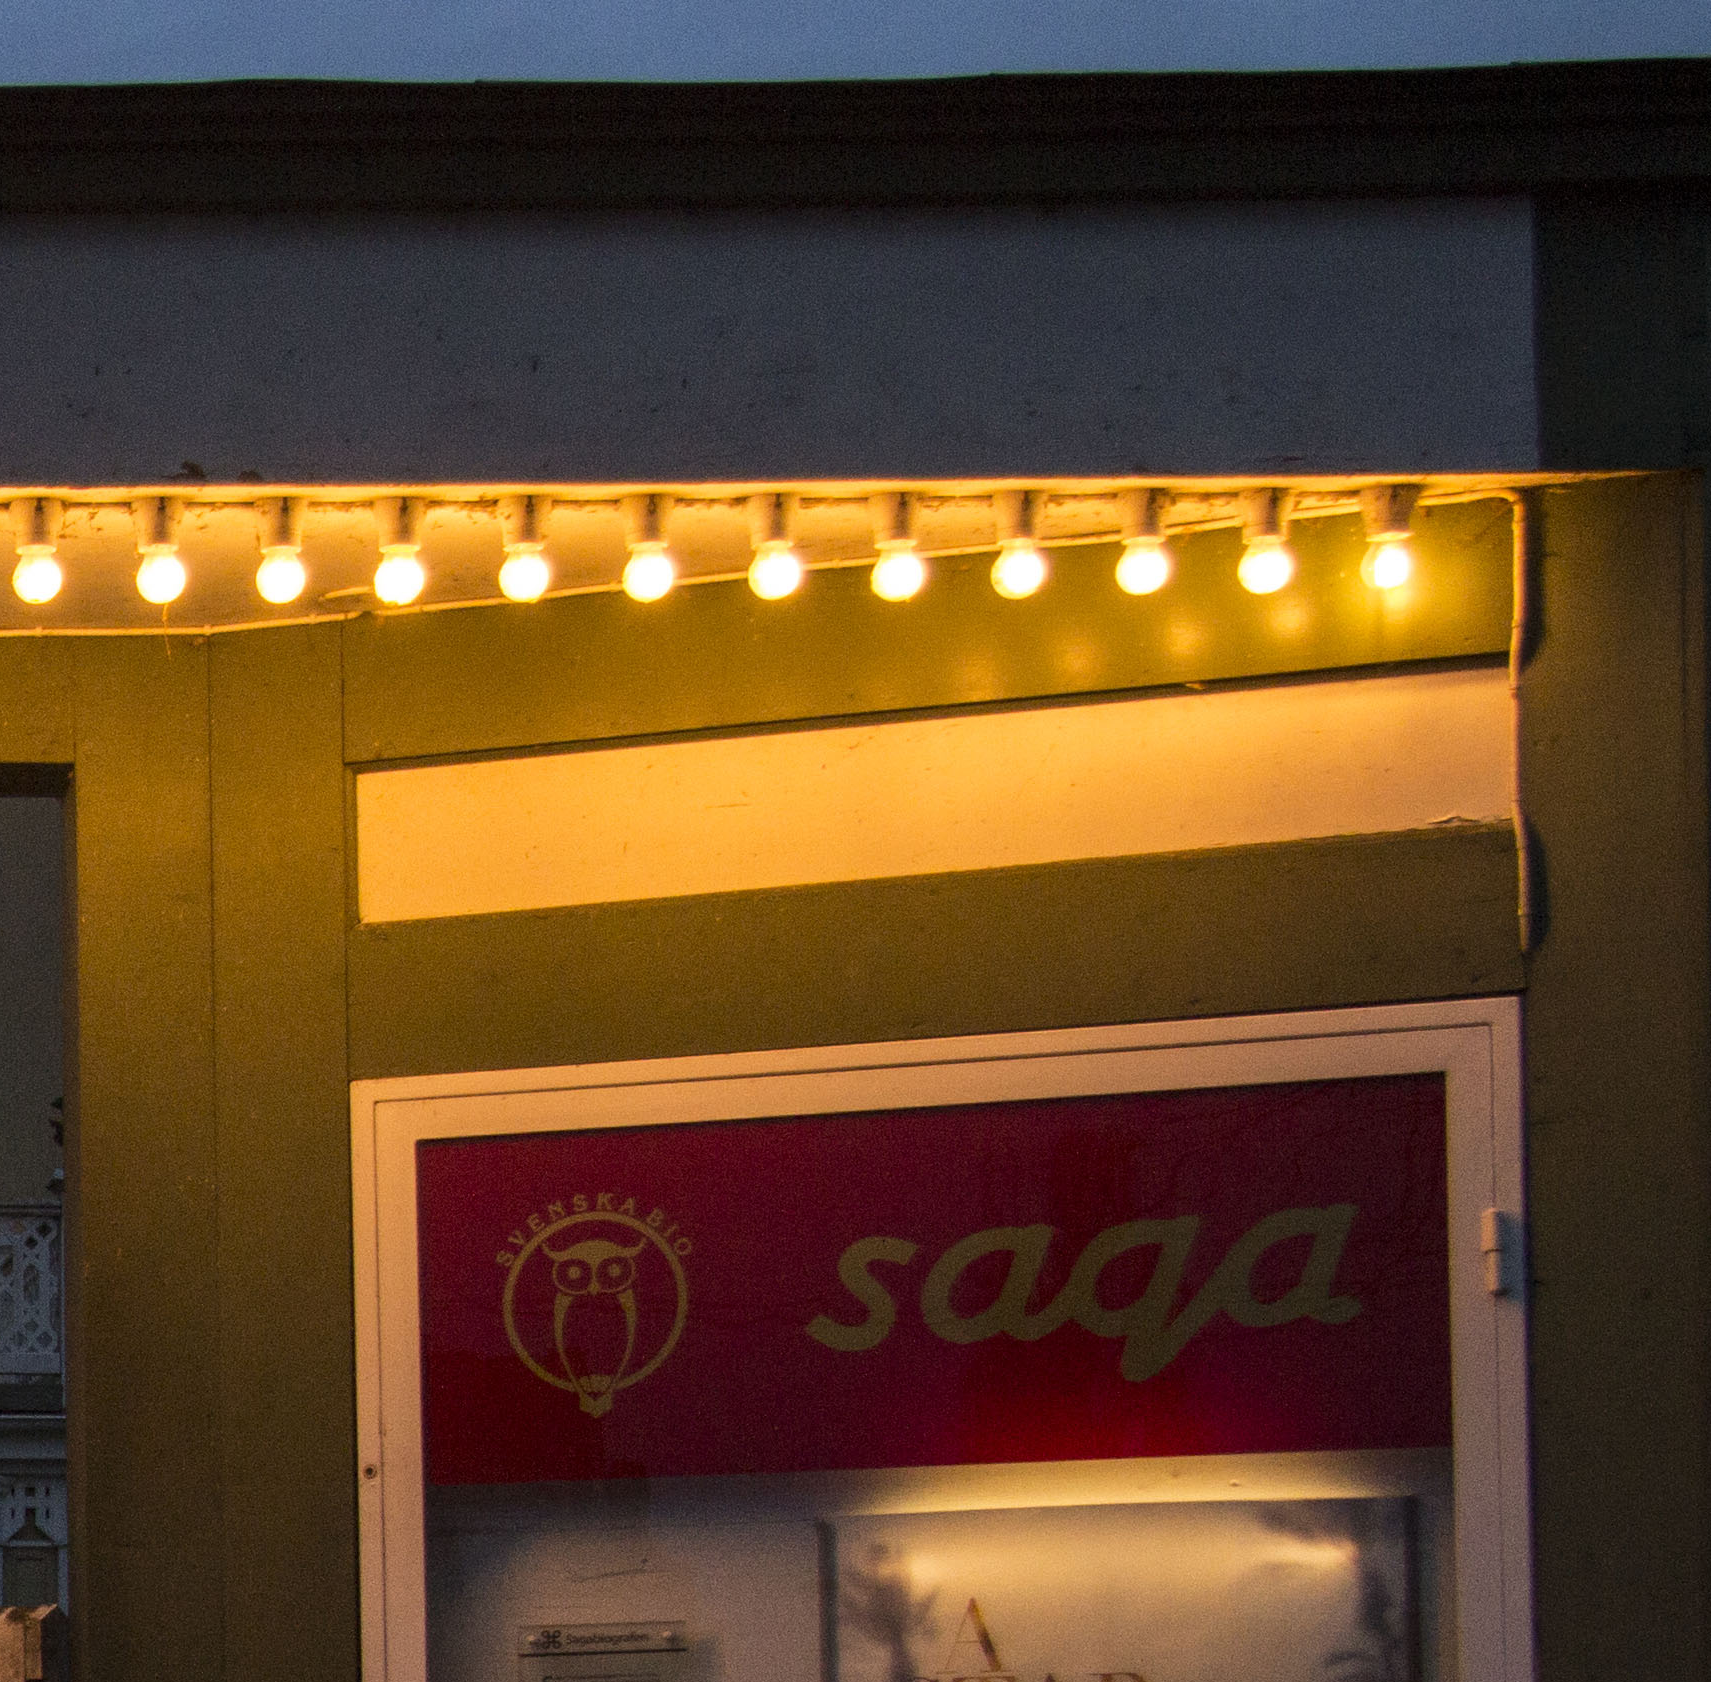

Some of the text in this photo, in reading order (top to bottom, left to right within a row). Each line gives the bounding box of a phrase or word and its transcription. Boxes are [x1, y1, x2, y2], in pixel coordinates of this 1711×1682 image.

[495, 1191, 696, 1268] SVENSKA BIO
[806, 1203, 1362, 1383] saga
[933, 1597, 1008, 1673] A
